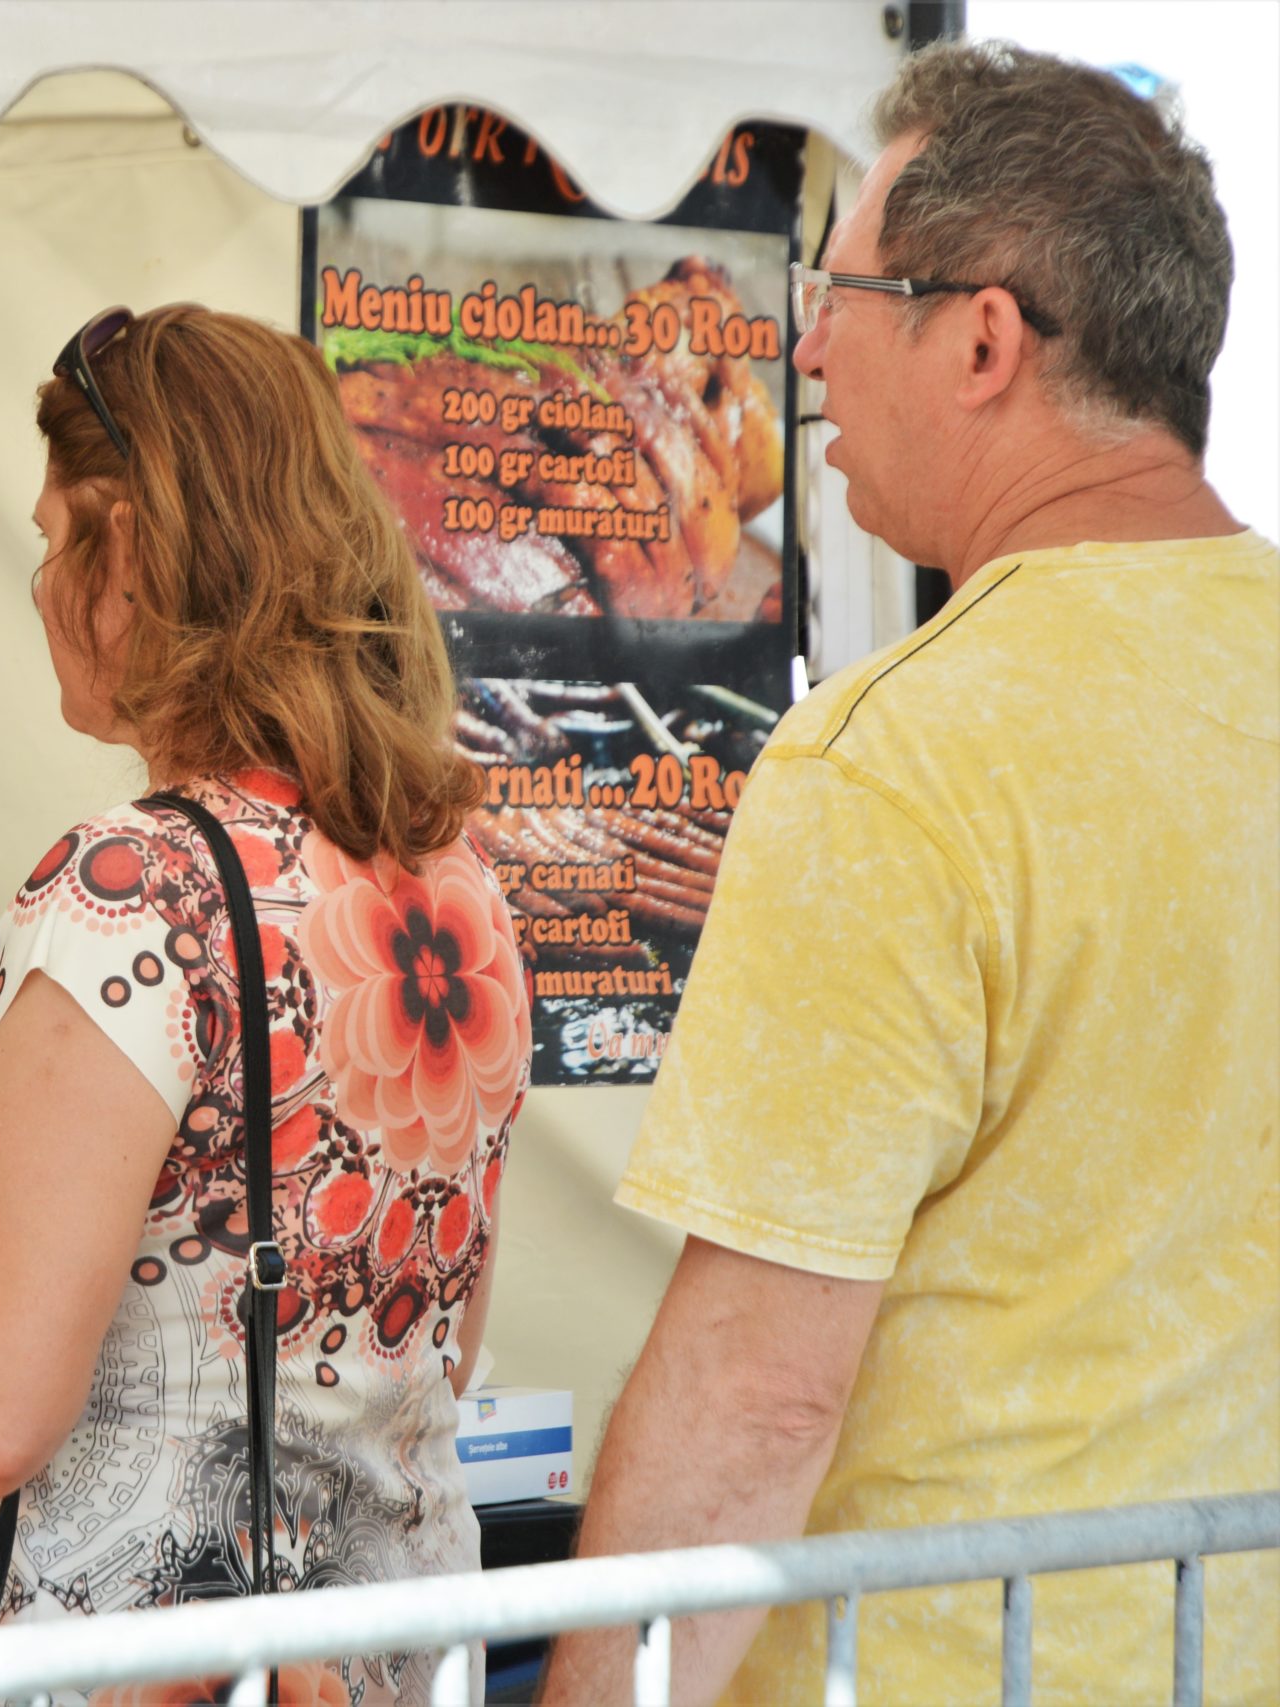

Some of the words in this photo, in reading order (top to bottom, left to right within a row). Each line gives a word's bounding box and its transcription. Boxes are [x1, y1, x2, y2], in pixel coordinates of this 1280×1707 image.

[322, 267, 452, 334] Meniu
[460, 280, 619, 348] ciolan...
[624, 302, 680, 357] 30
[689, 297, 780, 360] Ron
[443, 388, 497, 424] 200
[501, 395, 535, 433] gr
[539, 390, 634, 441] ciolan,
[444, 443, 495, 477] 100
[499, 449, 534, 487] gr
[538, 448, 636, 487] cartofi
[443, 498, 495, 532] 100
[499, 502, 533, 542] gr
[537, 503, 670, 541] muraturi
[487, 753, 584, 807] rnati
[629, 753, 683, 810] 20
[687, 755, 748, 810] Ro
[531, 855, 636, 892] carnati
[512, 915, 527, 944] r
[532, 909, 631, 944] cartofi
[535, 963, 673, 996] muraturi
[631, 1032, 671, 1057] mu
